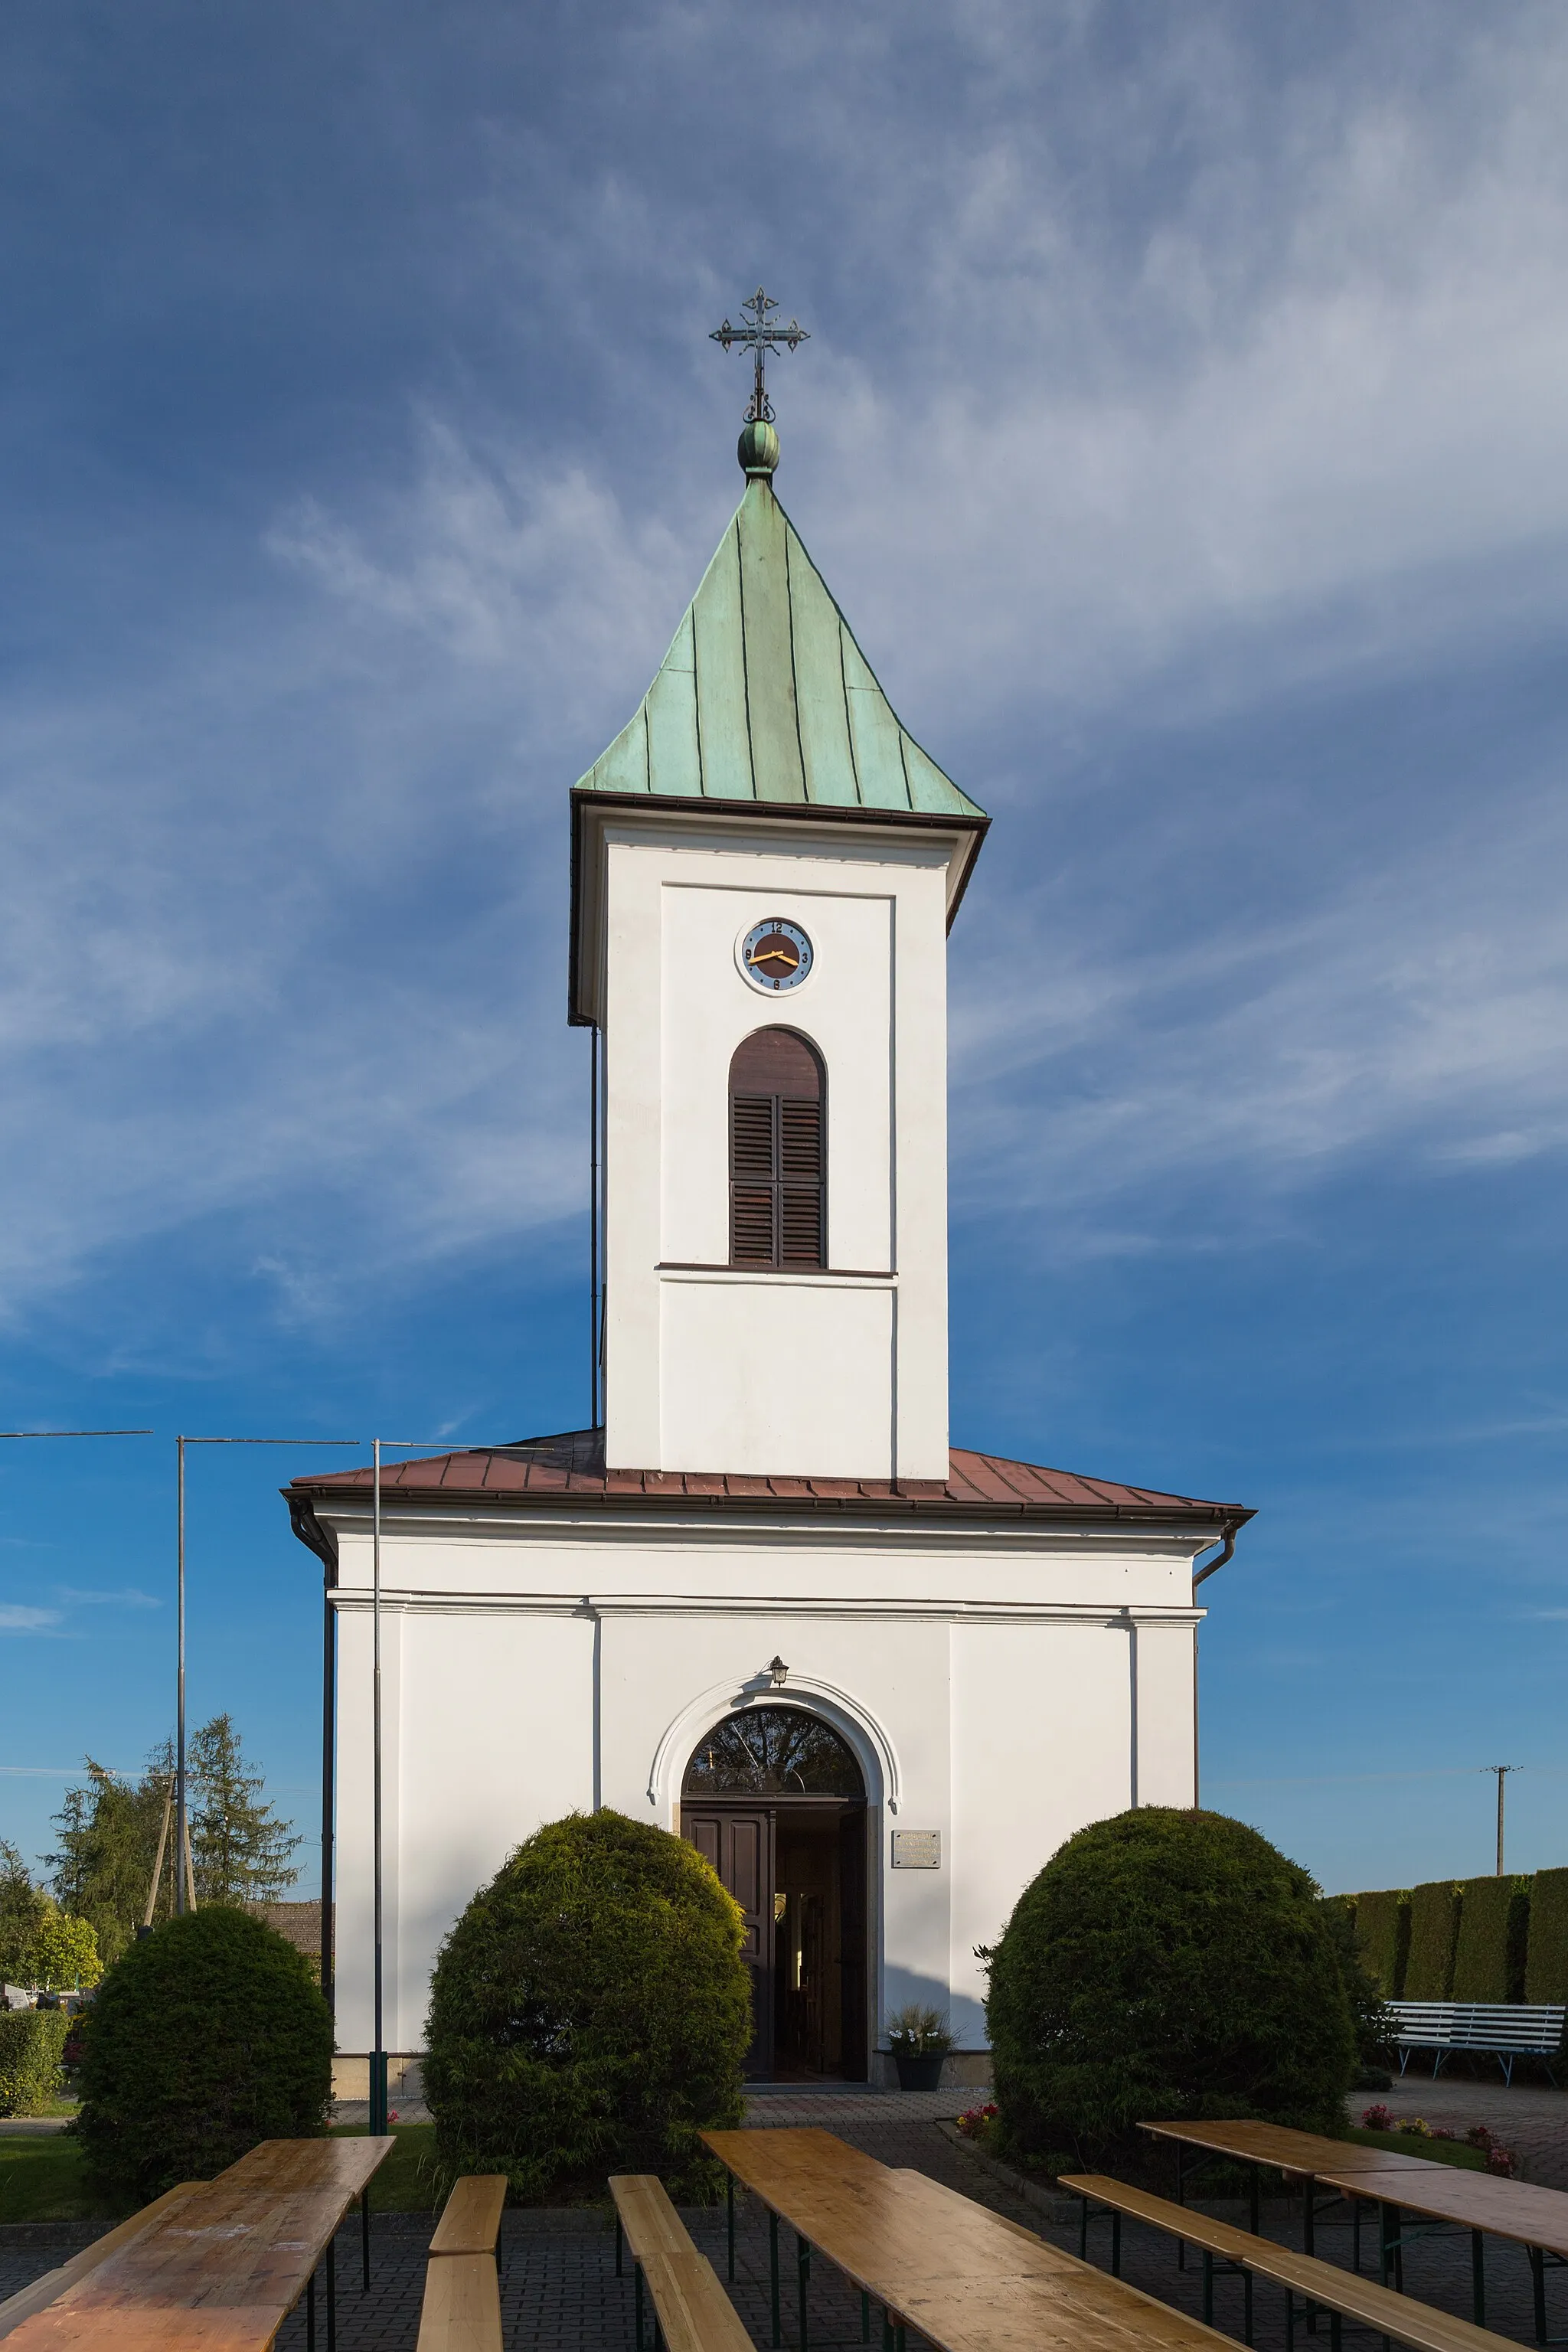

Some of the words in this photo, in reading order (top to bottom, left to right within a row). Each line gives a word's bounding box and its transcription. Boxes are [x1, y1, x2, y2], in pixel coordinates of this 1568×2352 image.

[772, 922, 782, 933] 12
[746, 949, 752, 959] 9
[802, 952, 808, 963] 3
[773, 979, 779, 990] 6
